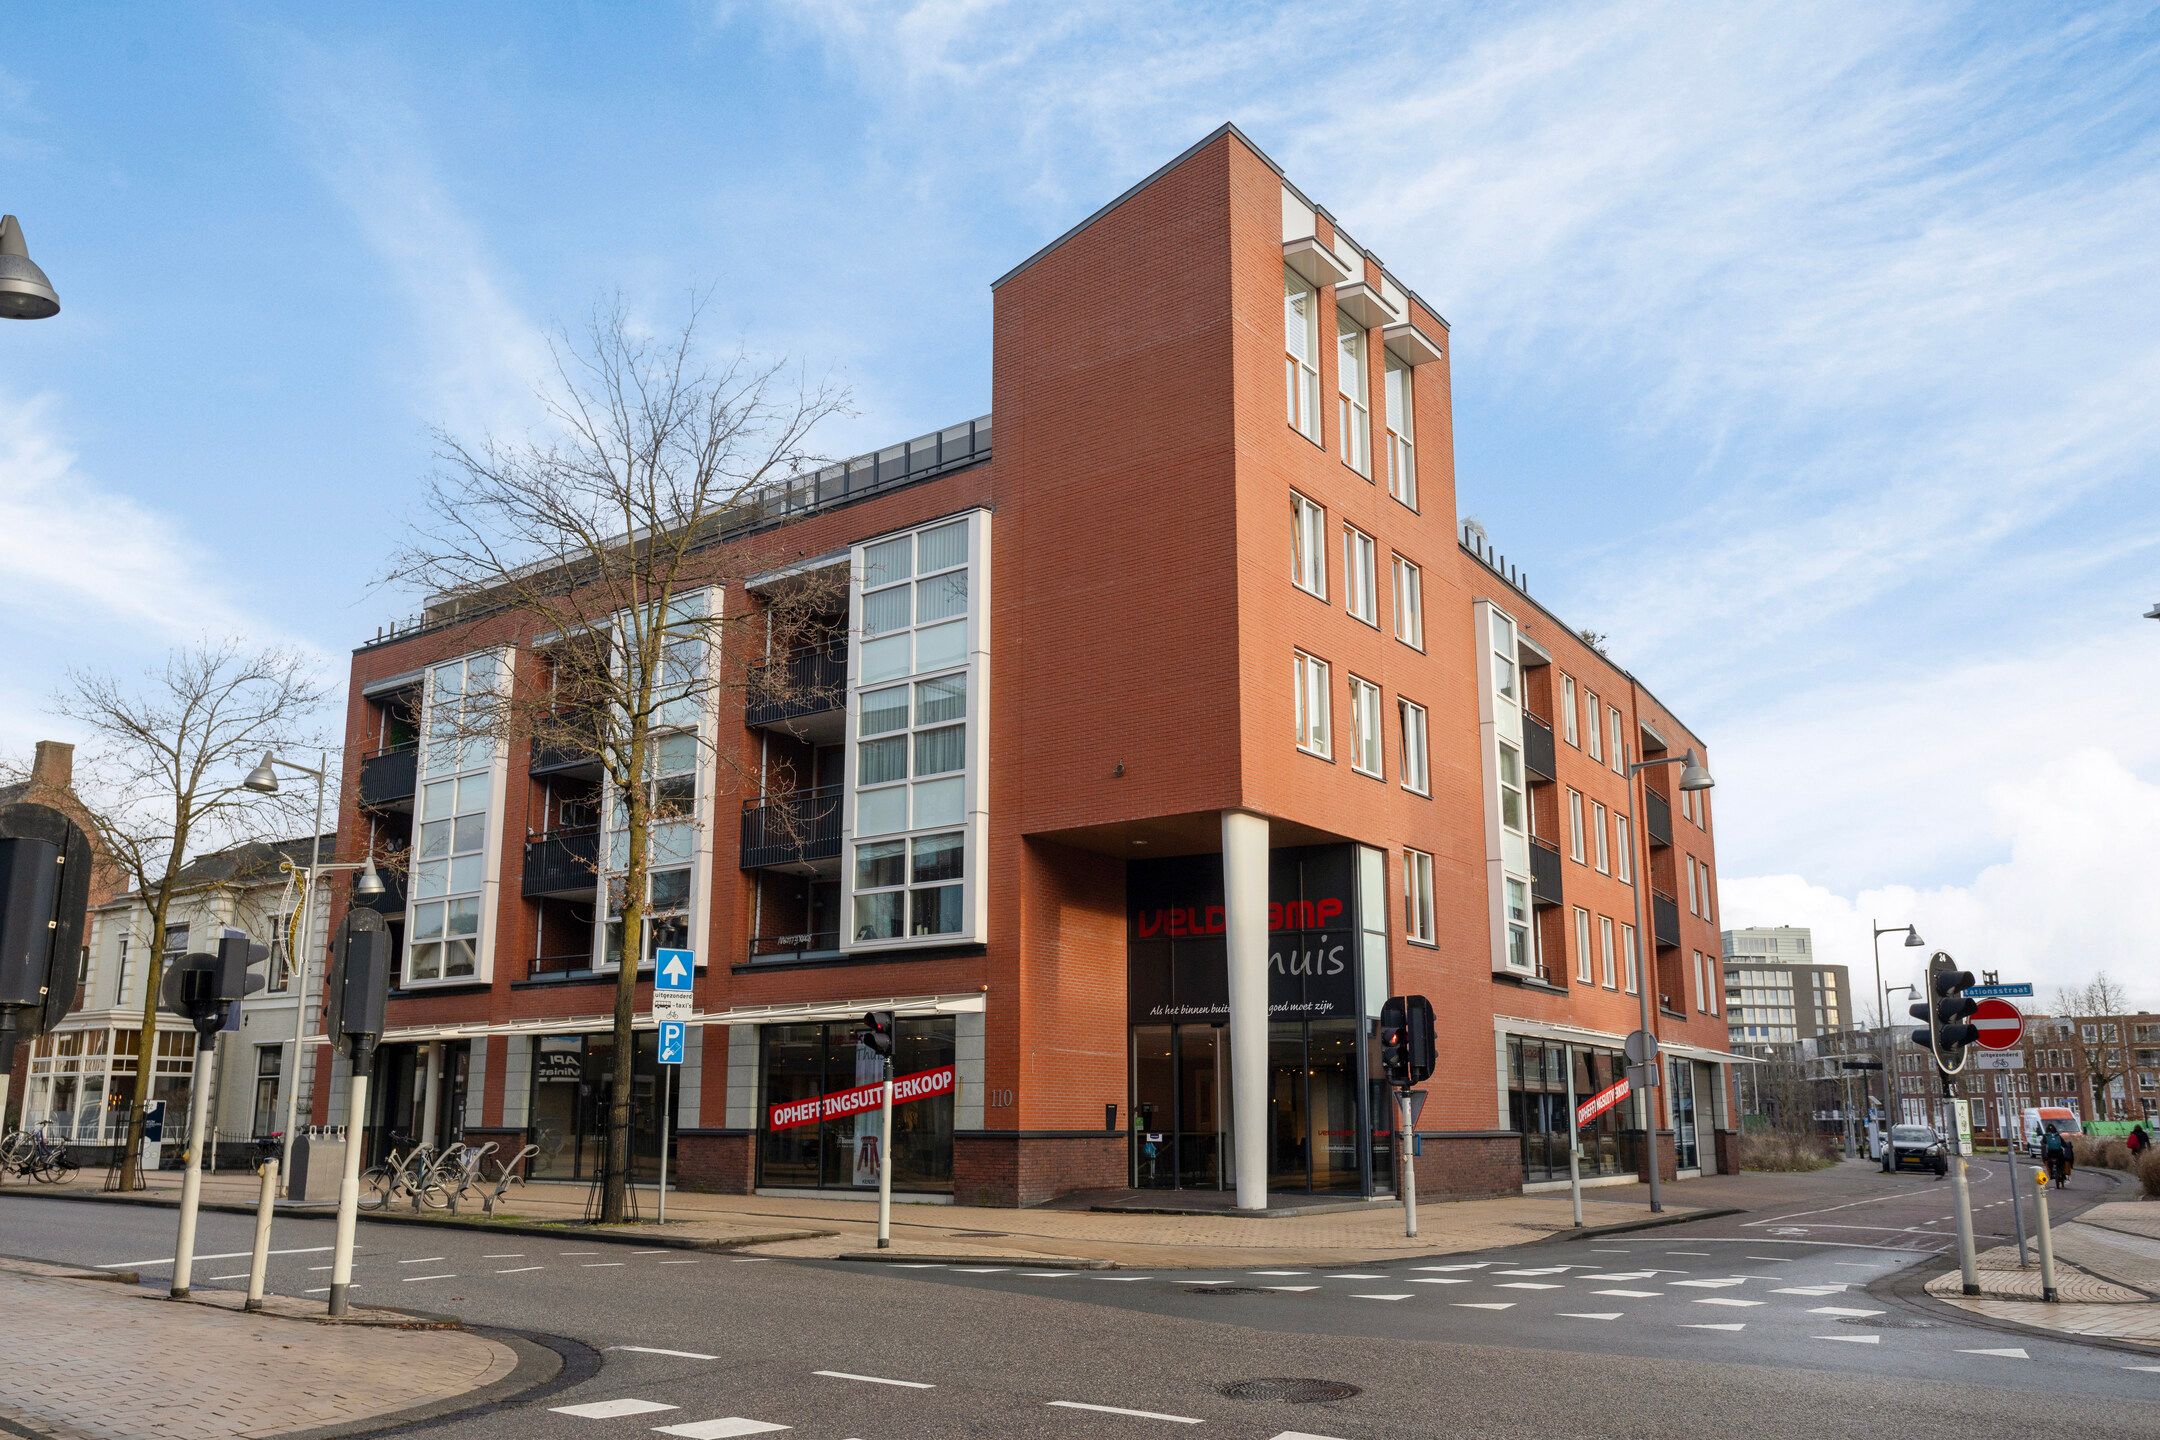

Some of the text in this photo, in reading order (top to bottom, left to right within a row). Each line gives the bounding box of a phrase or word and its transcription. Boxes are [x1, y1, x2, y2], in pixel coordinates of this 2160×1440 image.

[1138, 898, 1343, 937] VELDAMP
[1939, 953, 1947, 963] 24
[1965, 987, 2028, 995] tationsstraat
[1150, 1000, 1334, 1016] Als het binnen buite goed moet zijn
[664, 1025, 680, 1047] P
[774, 1070, 953, 1125] OPHEFFINGSUITERKOOP
[991, 1089, 1013, 1107] 110
